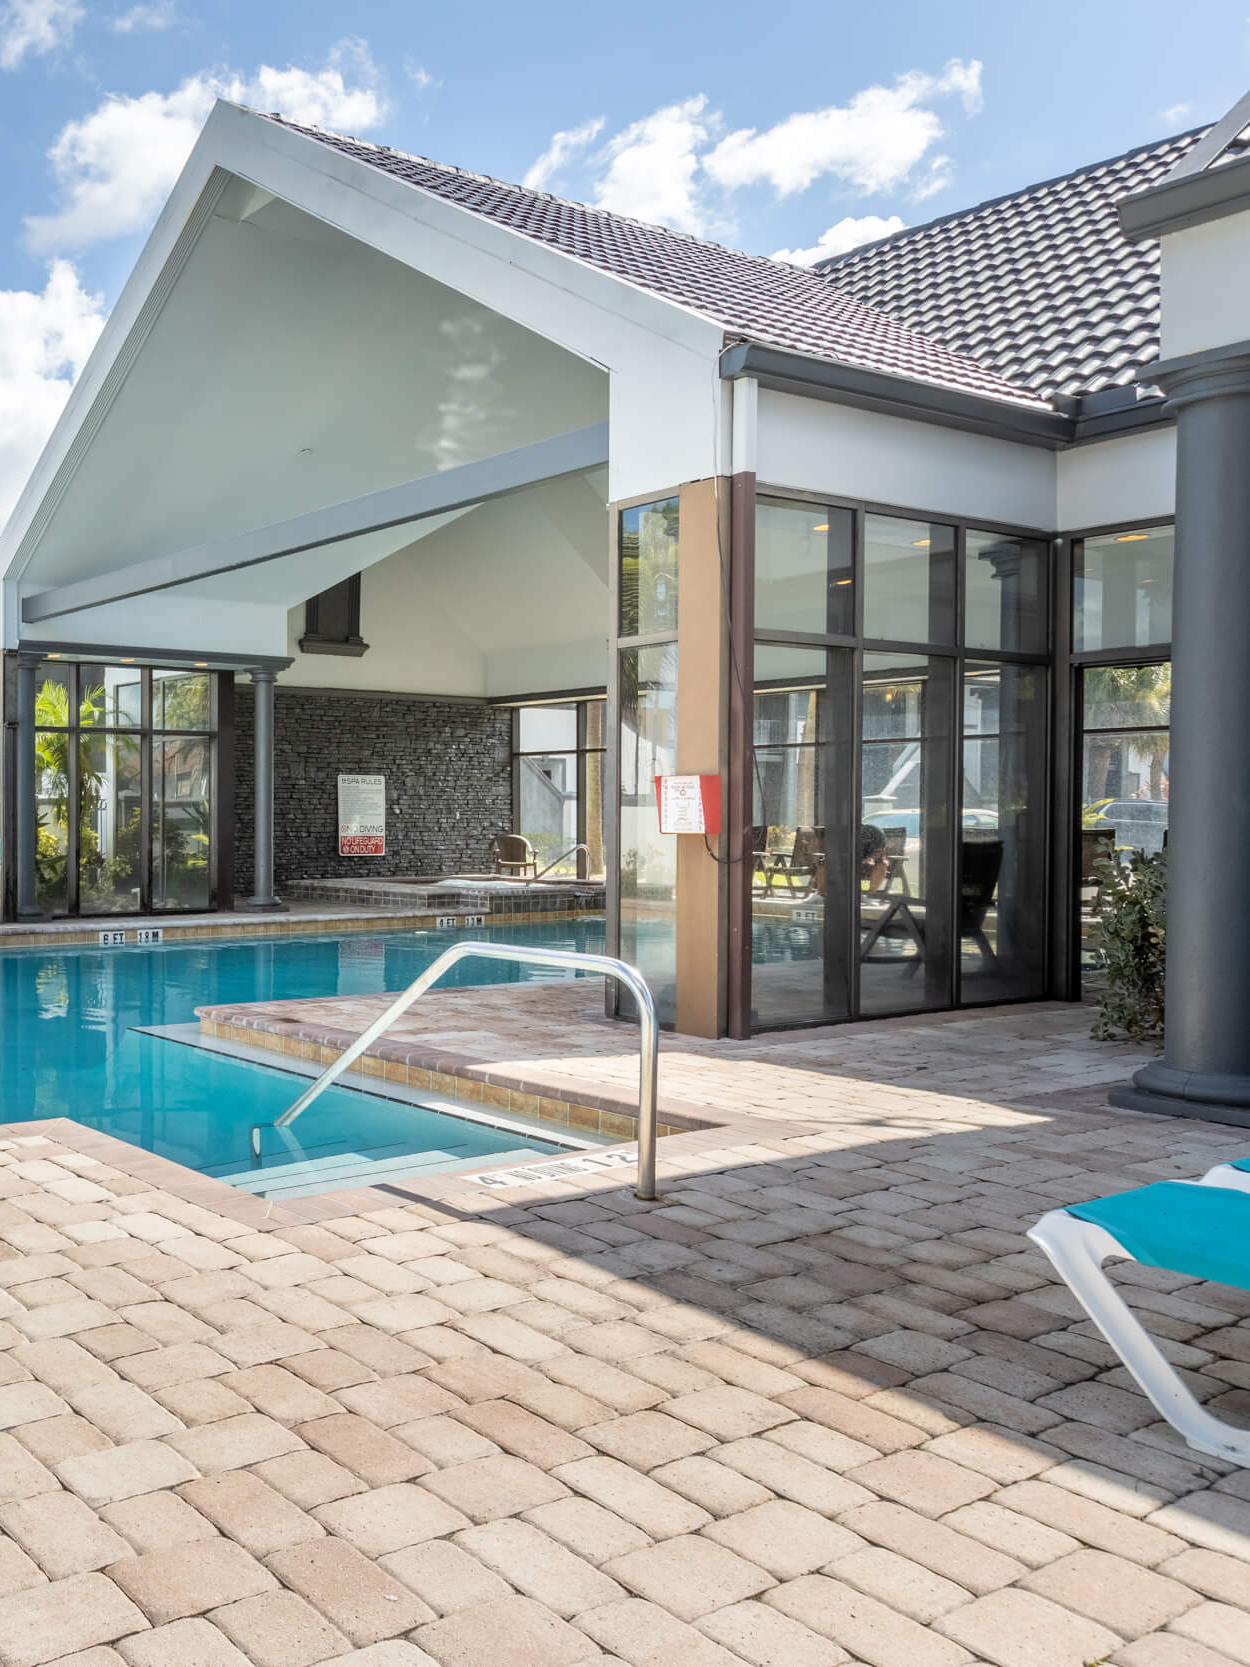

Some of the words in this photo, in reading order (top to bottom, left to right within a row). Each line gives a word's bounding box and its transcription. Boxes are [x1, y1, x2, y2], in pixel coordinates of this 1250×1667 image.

[360, 825, 383, 833] DIVING
[342, 836, 351, 845] NO
[352, 836, 383, 845] LIFEGUARD
[350, 845, 359, 854] ON
[360, 845, 375, 854] DUTY
[113, 933, 124, 945] FT
